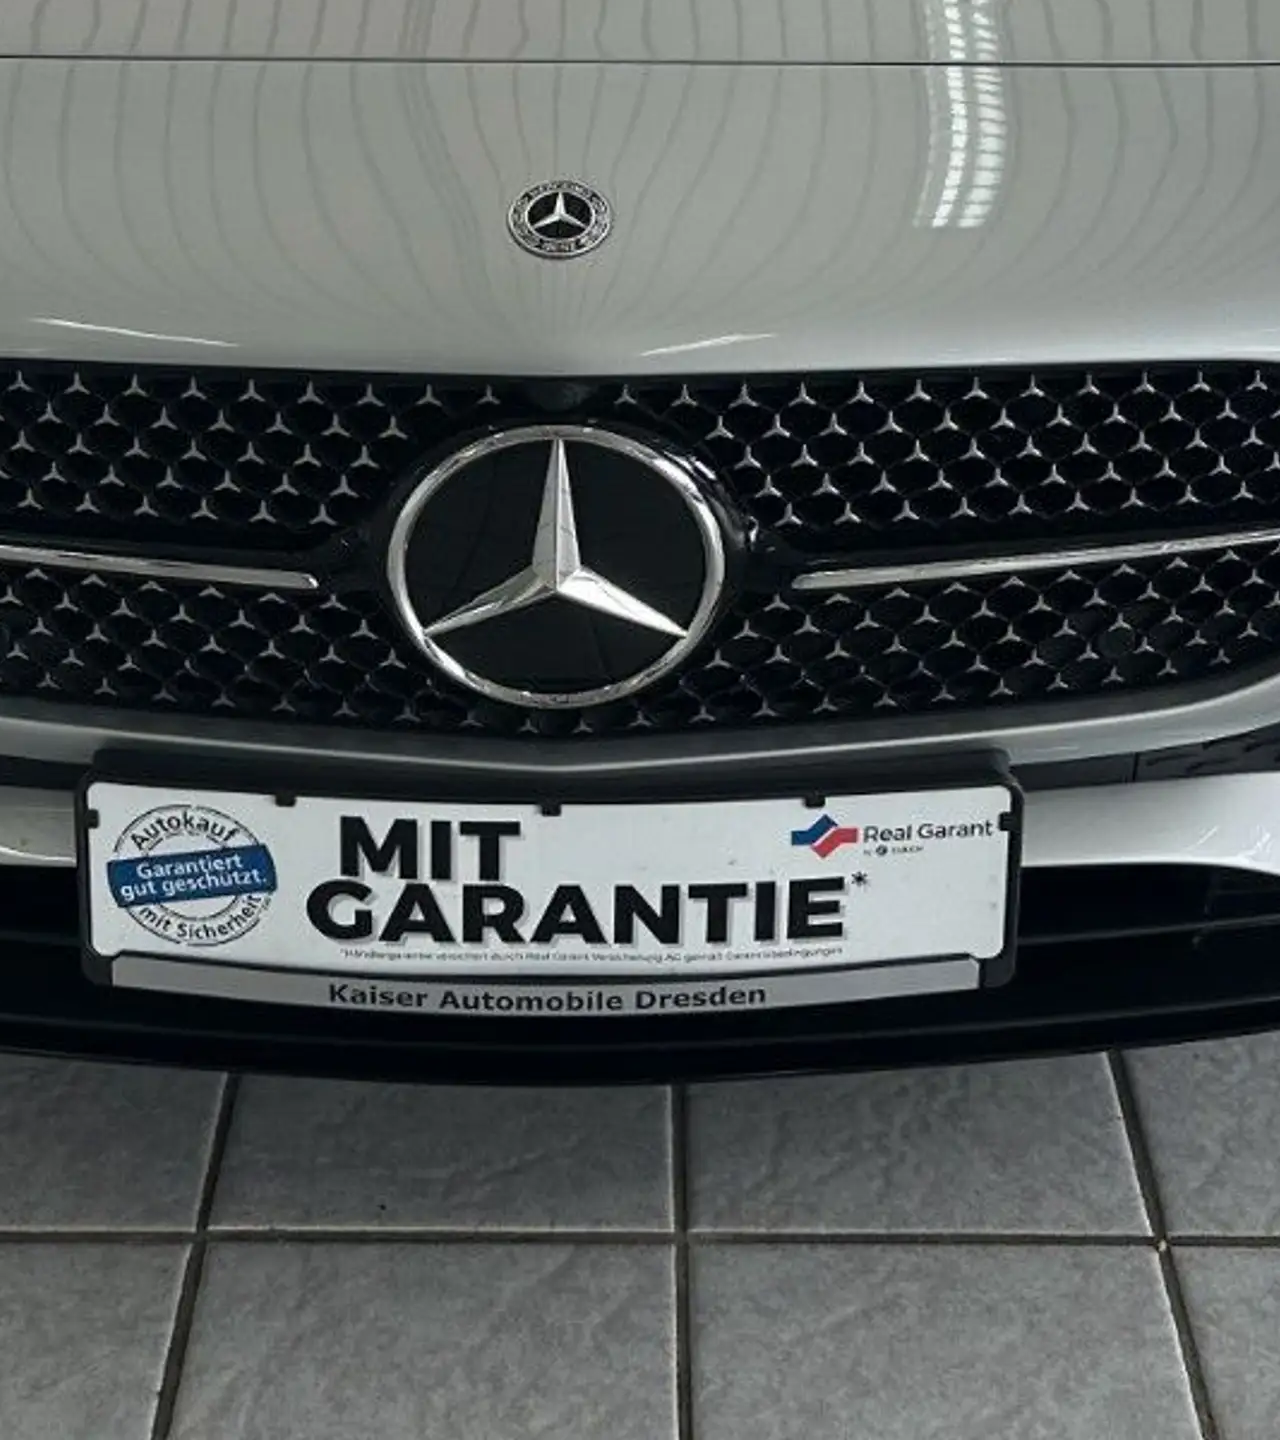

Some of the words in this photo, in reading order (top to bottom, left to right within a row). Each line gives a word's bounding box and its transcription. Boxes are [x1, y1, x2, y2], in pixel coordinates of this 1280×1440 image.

[131, 811, 241, 851] Autokauf
[864, 825, 912, 843] Real
[919, 819, 994, 840] Garant
[340, 816, 522, 881] MIT
[136, 853, 243, 880] Garantiert
[120, 880, 158, 901] gut
[138, 906, 172, 932] mit
[177, 894, 261, 940] Sicherheit
[329, 983, 428, 1007] Kaiser
[439, 989, 624, 1011] Automobile
[635, 986, 767, 1009] Dresden
